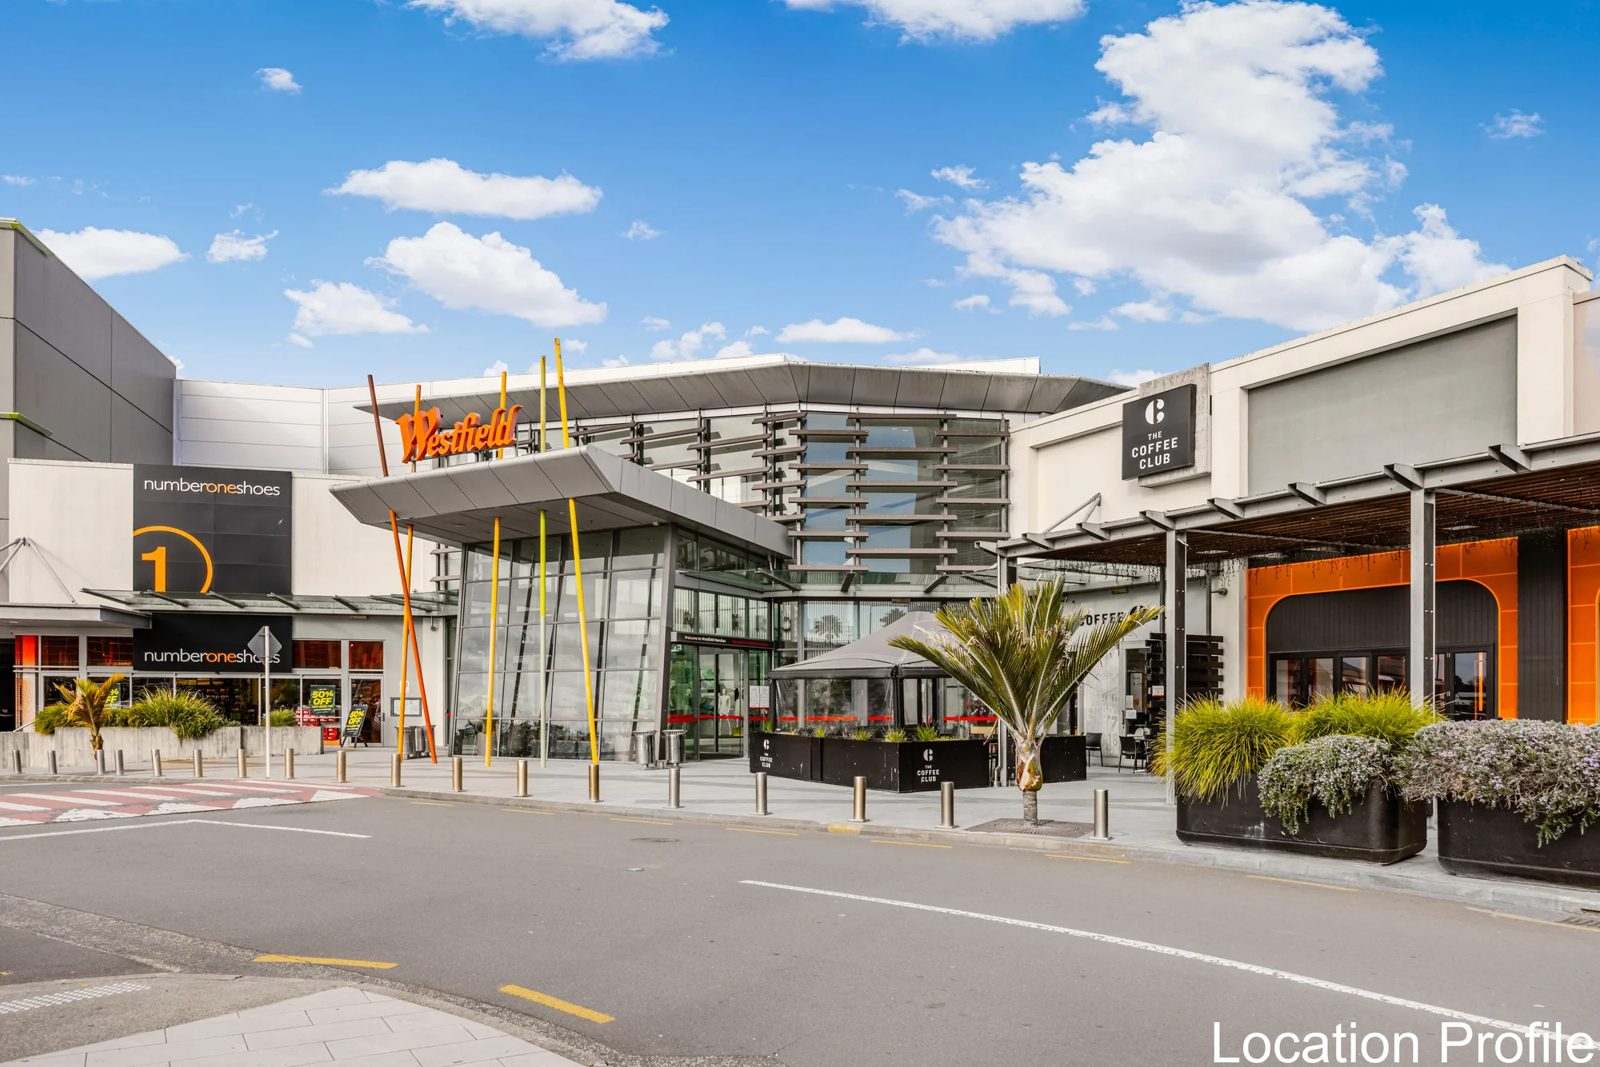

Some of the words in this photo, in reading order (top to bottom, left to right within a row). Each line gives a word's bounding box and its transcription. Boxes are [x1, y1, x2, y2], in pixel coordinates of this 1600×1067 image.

[396, 404, 522, 464] Westfield
[1148, 431, 1162, 440] THE
[1131, 437, 1178, 458] COFFEE
[1139, 453, 1170, 469] CLUB
[144, 477, 280, 496] numberoneshoes
